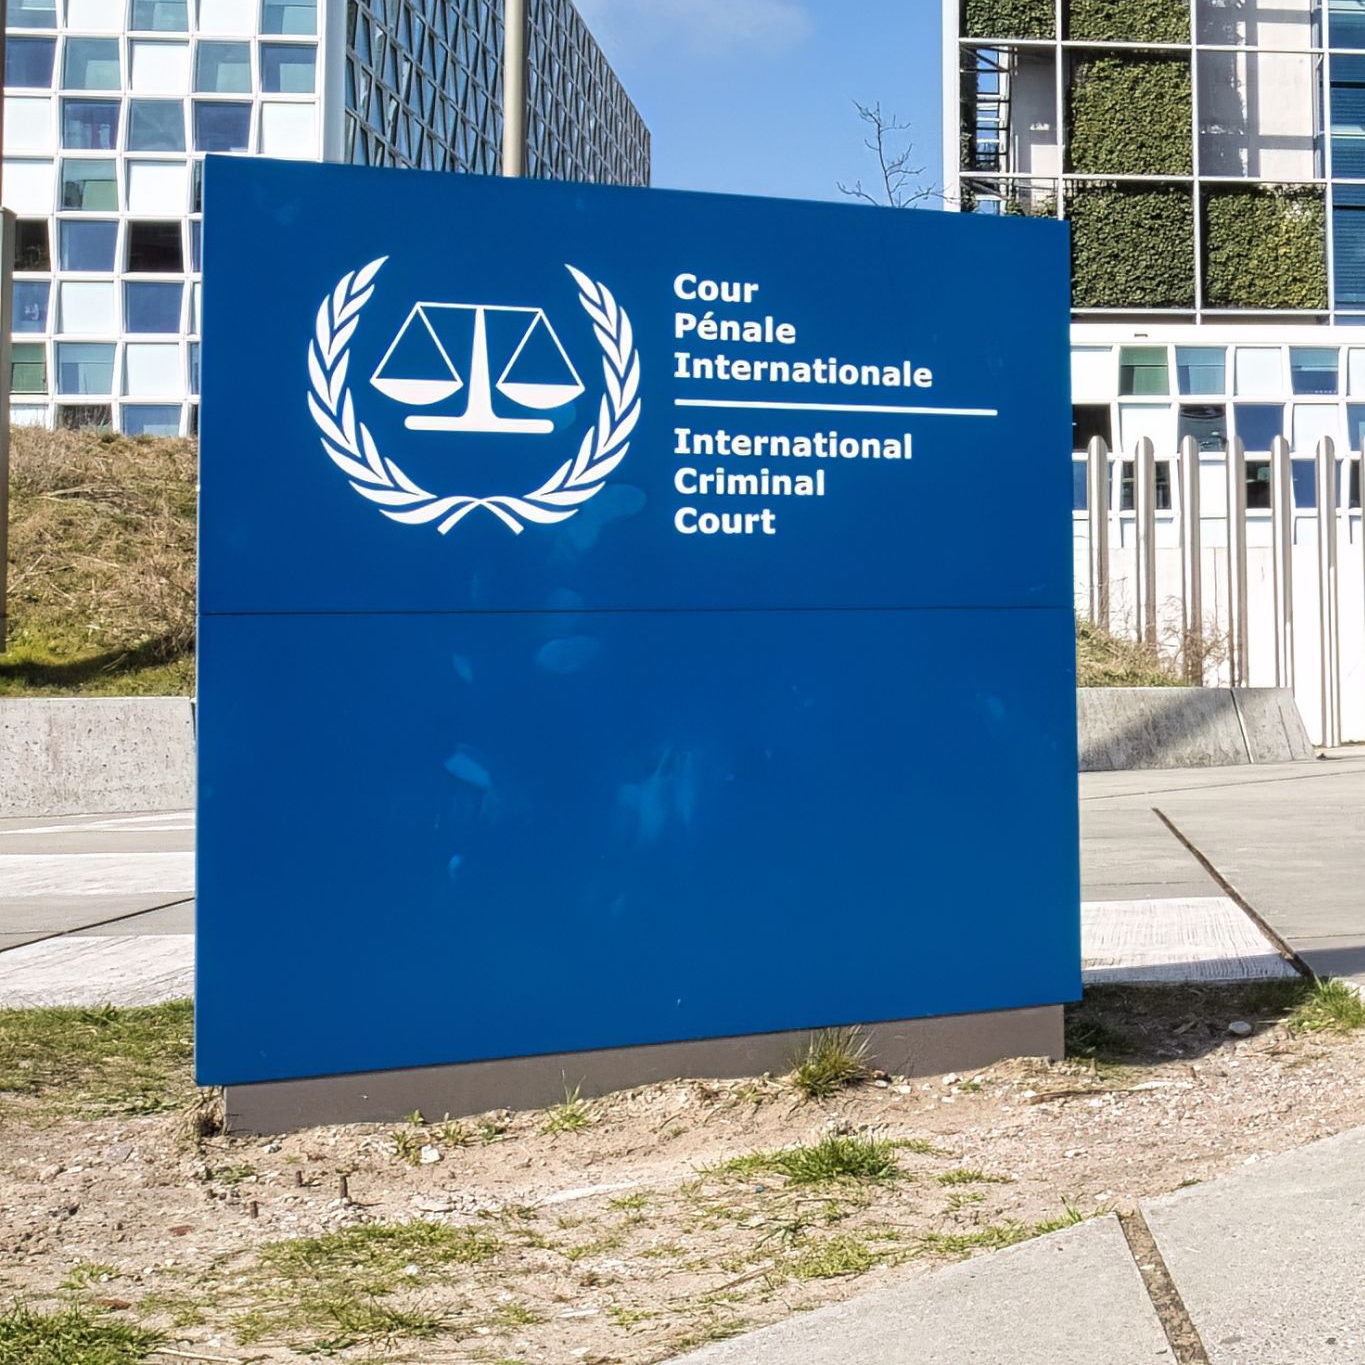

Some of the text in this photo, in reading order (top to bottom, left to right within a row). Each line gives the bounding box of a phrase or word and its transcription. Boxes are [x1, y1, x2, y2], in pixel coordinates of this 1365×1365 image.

[673, 273, 759, 303] Cour
[673, 311, 797, 344] Pénale
[673, 351, 933, 388] Internationale
[674, 427, 912, 460] International
[674, 467, 825, 496] Criminal
[674, 506, 776, 535] Court
